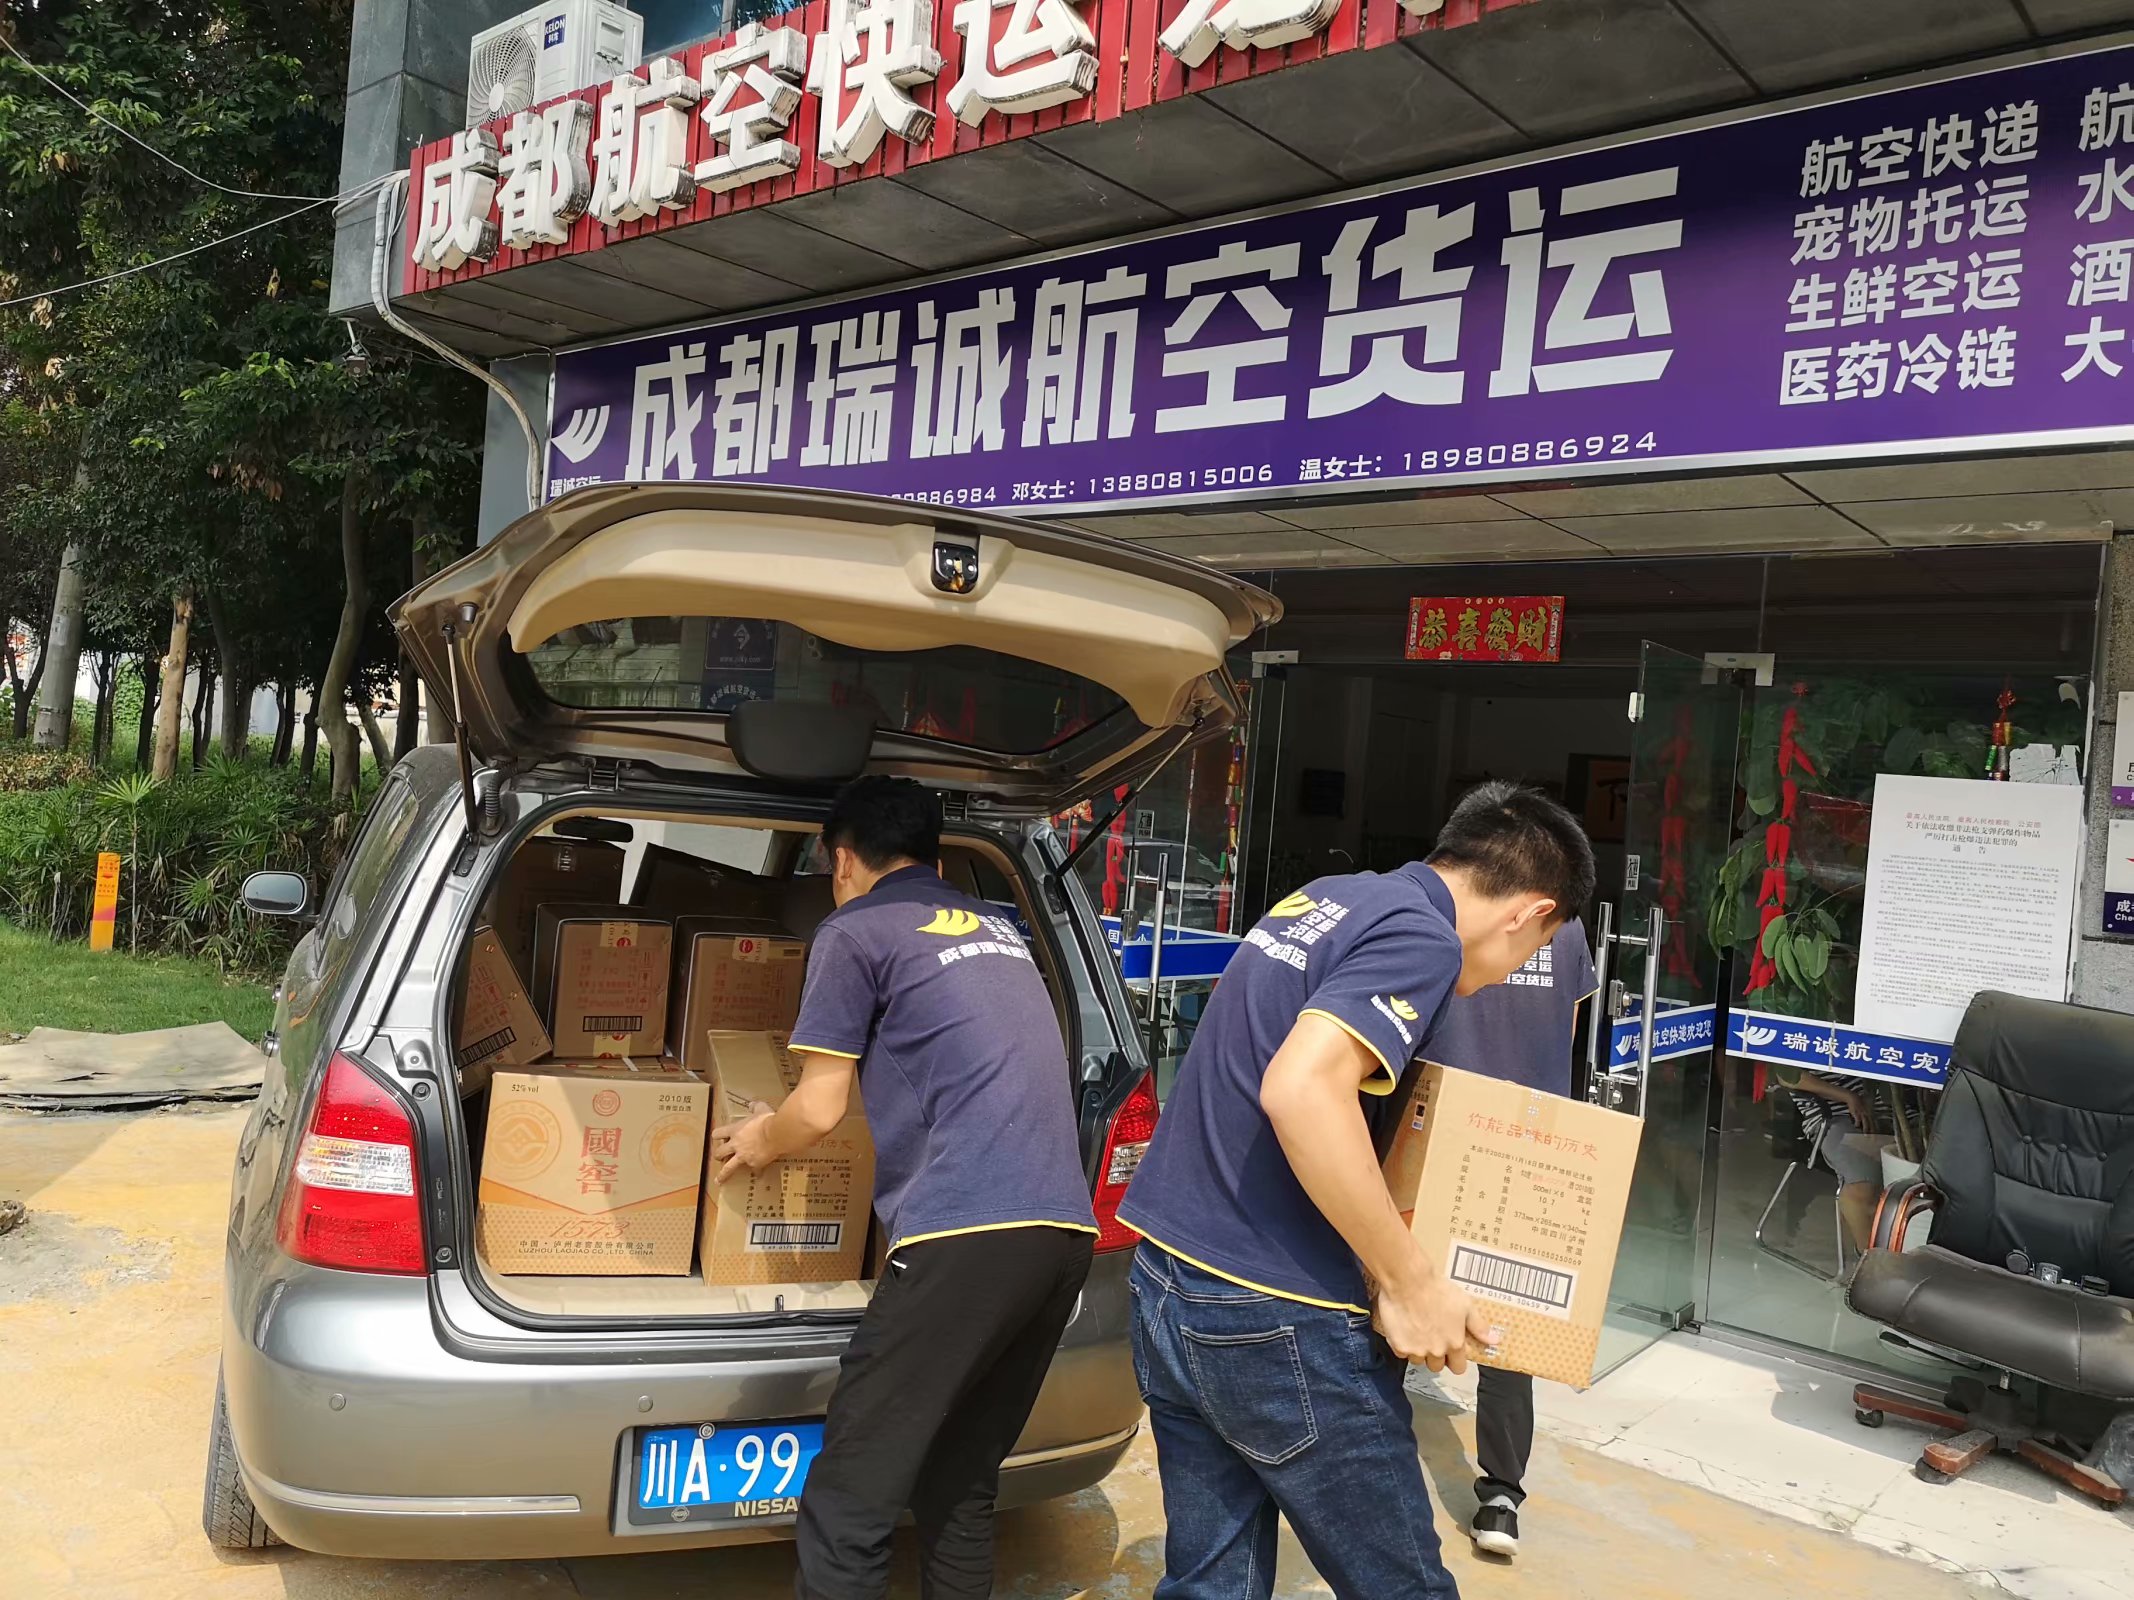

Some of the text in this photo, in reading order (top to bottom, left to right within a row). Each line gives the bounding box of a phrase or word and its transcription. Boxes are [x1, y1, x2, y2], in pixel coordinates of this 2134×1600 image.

[411, 0, 1101, 273] 成都航空快运
[1799, 100, 2039, 198] 航空快递
[2078, 82, 2134, 152] 航
[1790, 174, 2030, 266] 宠物托运
[2074, 158, 2134, 224] 水
[1784, 248, 2023, 333] 生鲜空运
[2067, 239, 2134, 307] 酒
[625, 166, 1683, 482] 成都瑞诚航空货运
[1779, 325, 2017, 406] 医药冷链
[881, 486, 996, 505] 886984
[1089, 464, 1273, 495] 13880815006
[1404, 431, 1658, 471] 18980886924
[2116, 900, 2134, 913] 成
[1631, 1020, 1712, 1052] 瑞航空快递欢迎您
[1782, 1031, 1954, 1074] 瑞诚航空宠
[1466, 1112, 1599, 1162] 你能品味的历史
